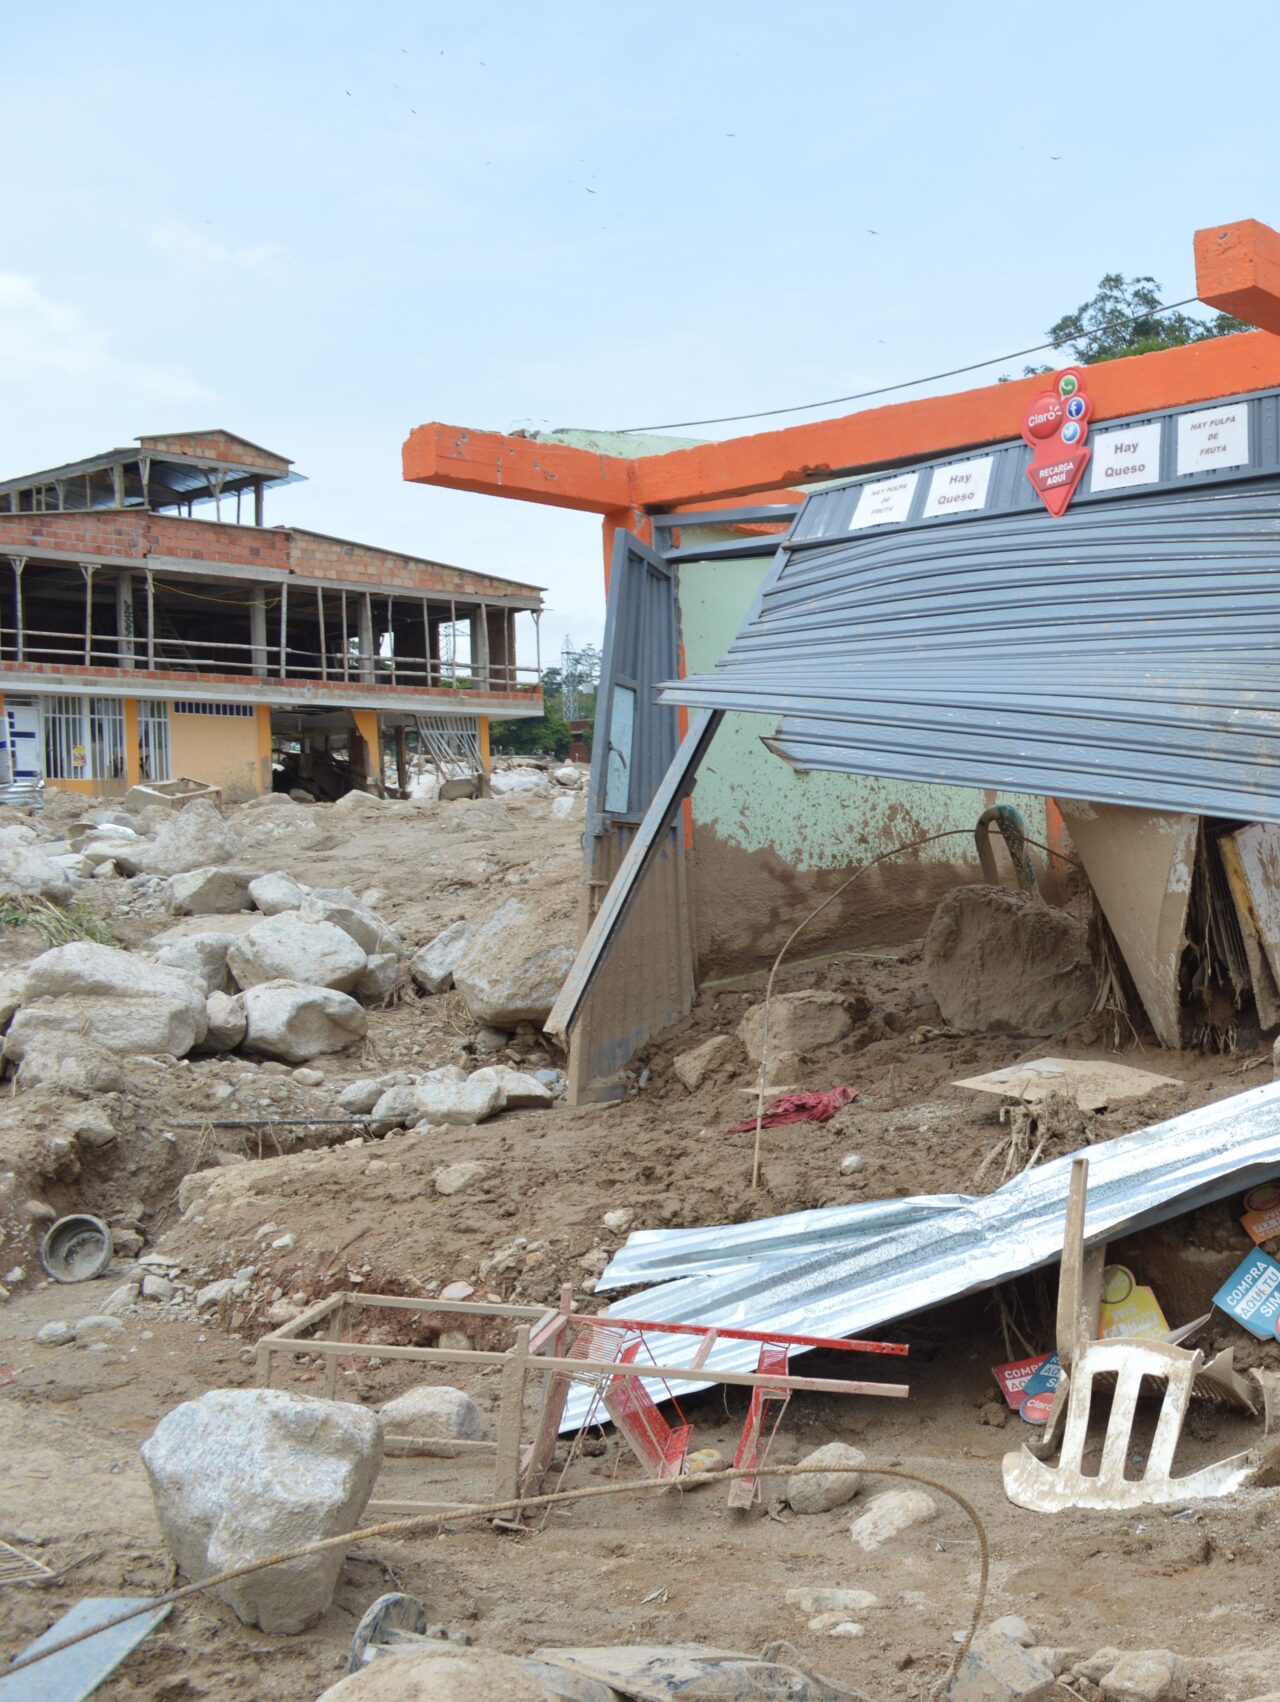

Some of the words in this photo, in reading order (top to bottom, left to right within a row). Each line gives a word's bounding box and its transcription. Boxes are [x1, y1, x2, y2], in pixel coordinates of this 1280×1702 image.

[1028, 409, 1057, 427] Claro
[1190, 420, 1207, 431] HAY
[1209, 415, 1236, 428] PULPA
[1207, 432, 1219, 441] DE
[1114, 442, 1139, 454] Hay
[1199, 445, 1227, 455] FRUTA
[1039, 461, 1074, 478] RECARGA
[1104, 464, 1145, 478] Queso
[949, 474, 972, 485] Hay
[937, 492, 975, 505] Queso
[1226, 1261, 1267, 1305] COMPRA
[1264, 1270, 1280, 1290] TU
[1004, 1362, 1044, 1379] COMP
